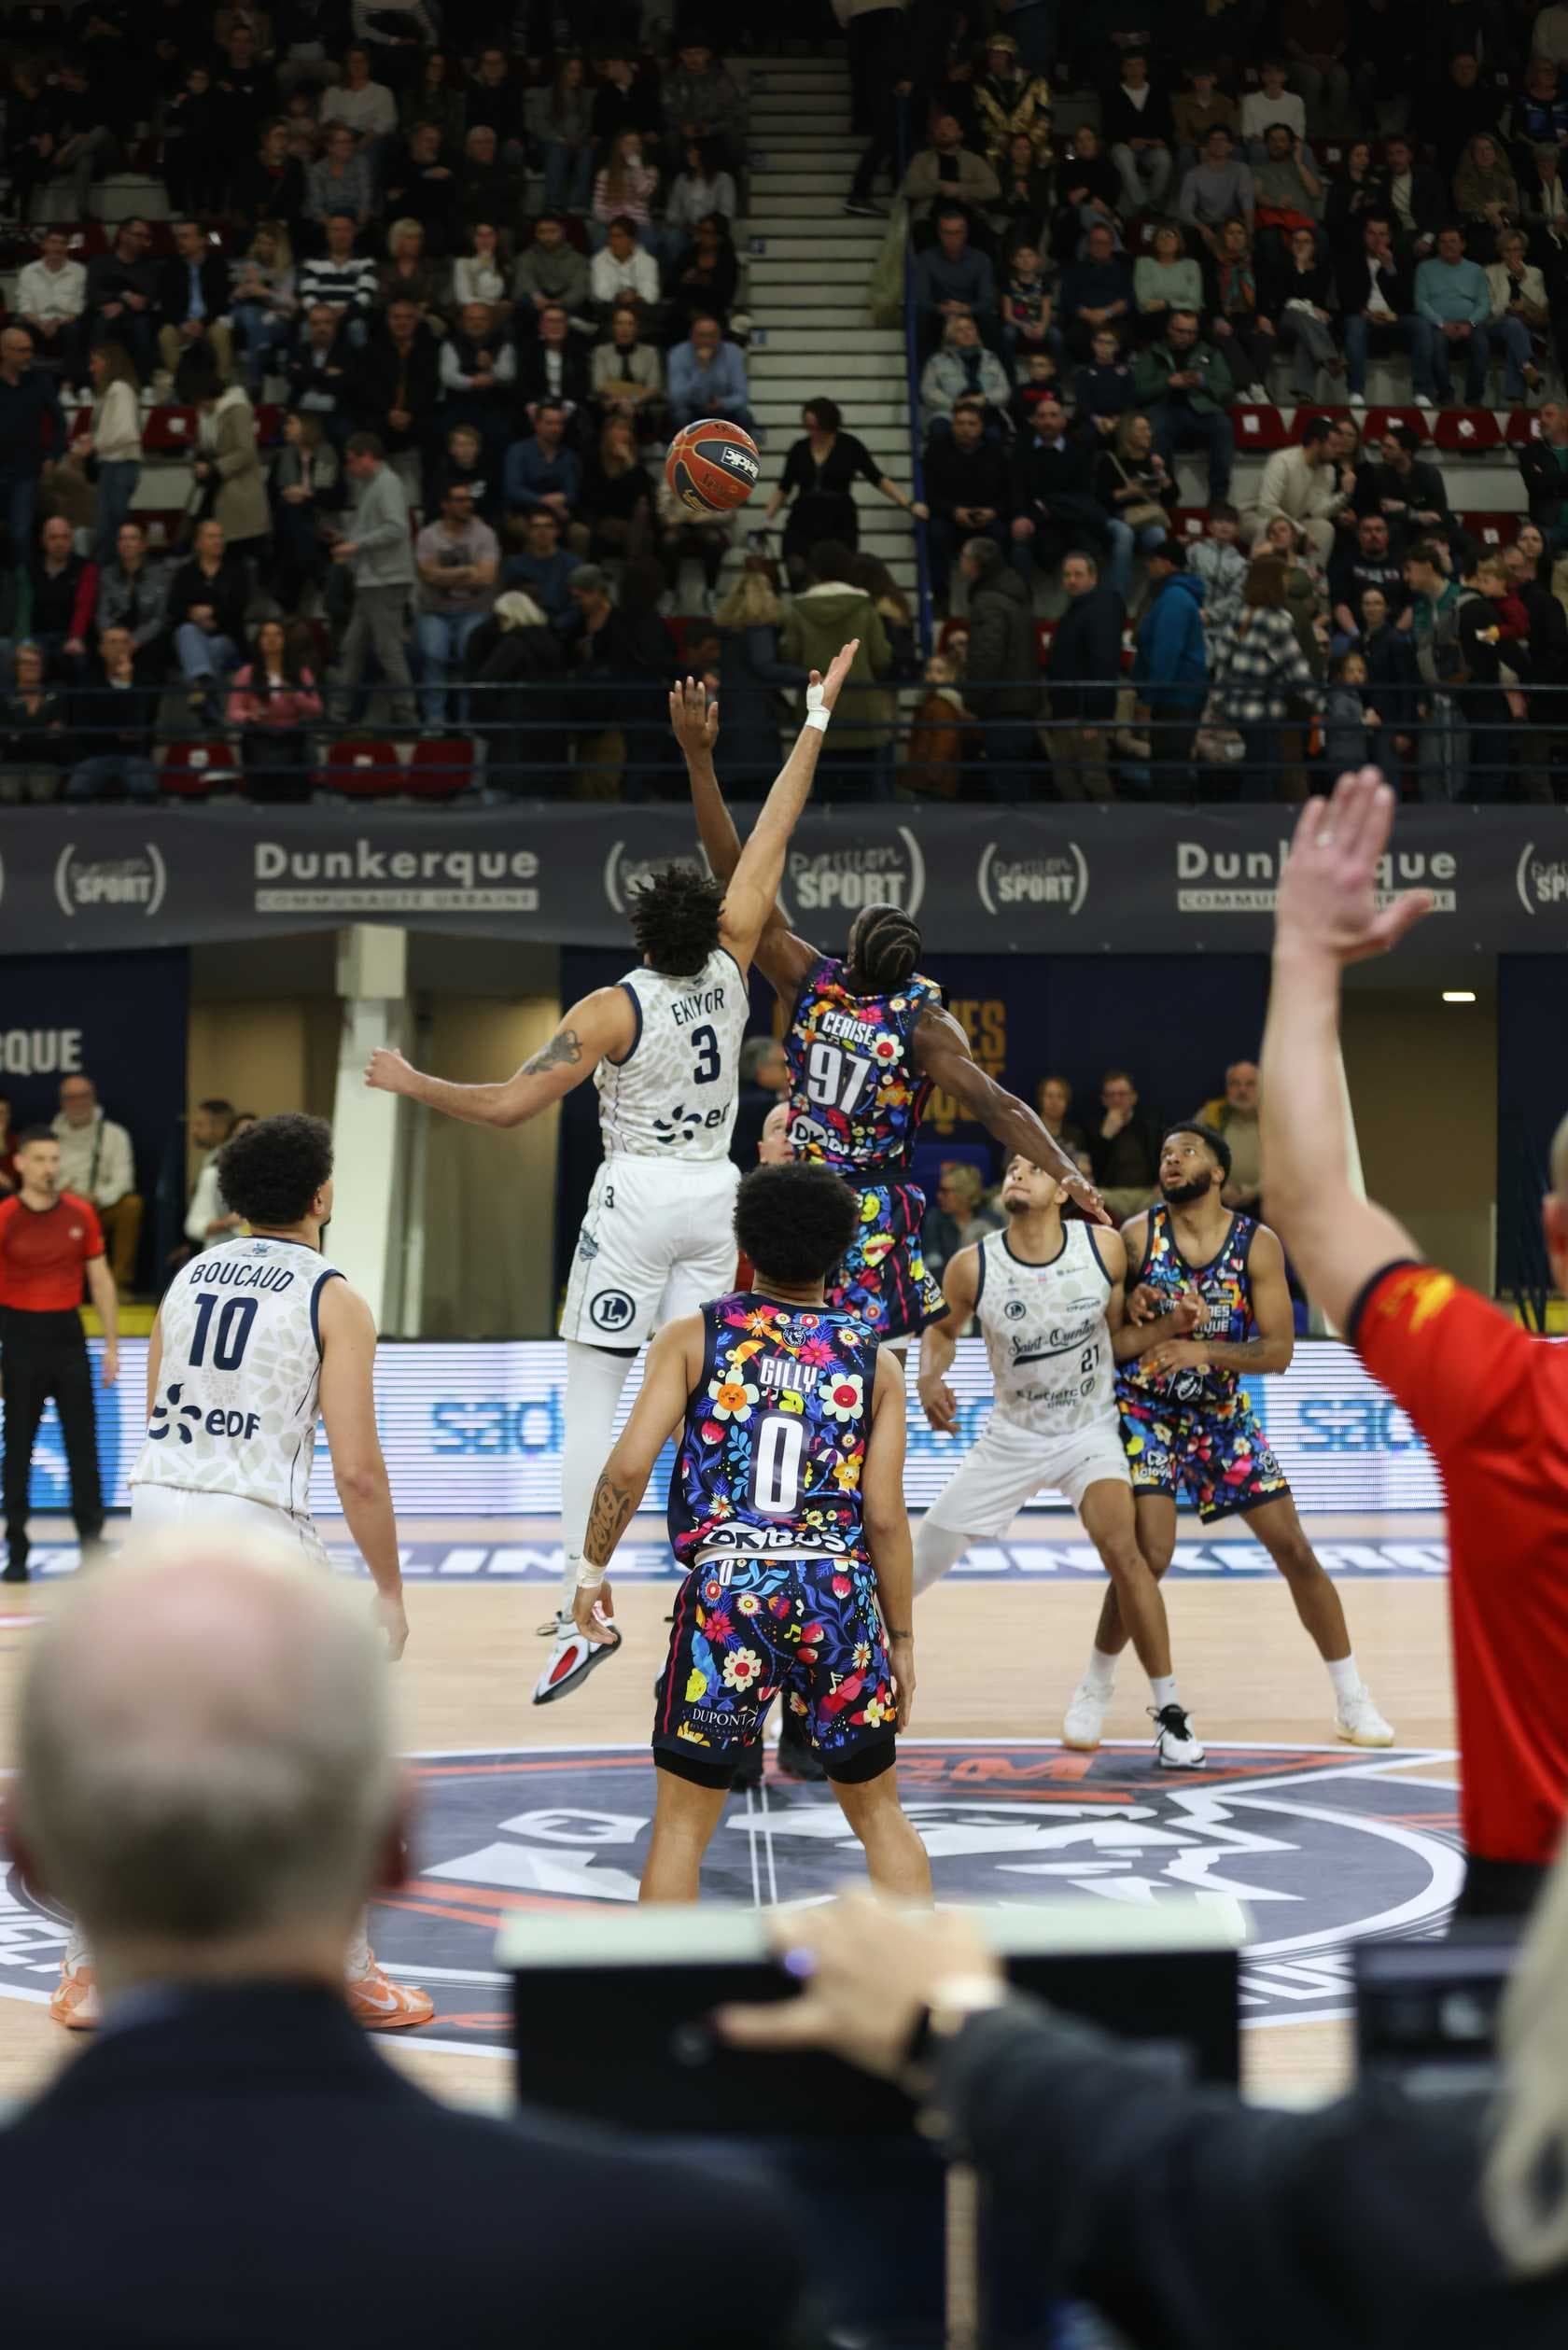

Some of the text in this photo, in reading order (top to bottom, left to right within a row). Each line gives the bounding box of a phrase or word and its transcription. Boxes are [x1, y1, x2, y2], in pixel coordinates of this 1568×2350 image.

[254, 839, 539, 888] Dunkerque
[1177, 839, 1456, 888] Dunque
[795, 871, 905, 909] SPORT
[998, 874, 1074, 902] SPORT
[671, 988, 725, 1026] EKIYOR
[821, 1011, 875, 1046] CERISE
[0, 1028, 83, 1077] QUE
[691, 1024, 721, 1085] 3
[806, 1042, 872, 1114] 97
[605, 1185, 614, 1209] 3
[189, 1262, 295, 1294] BOUCAUD
[188, 1293, 259, 1371] 10
[760, 1357, 818, 1393] GILLY
[1081, 1344, 1099, 1374] 21
[754, 1416, 804, 1513] 0
[720, 1560, 735, 1587] 0
[693, 1707, 748, 1727] DUPONT
